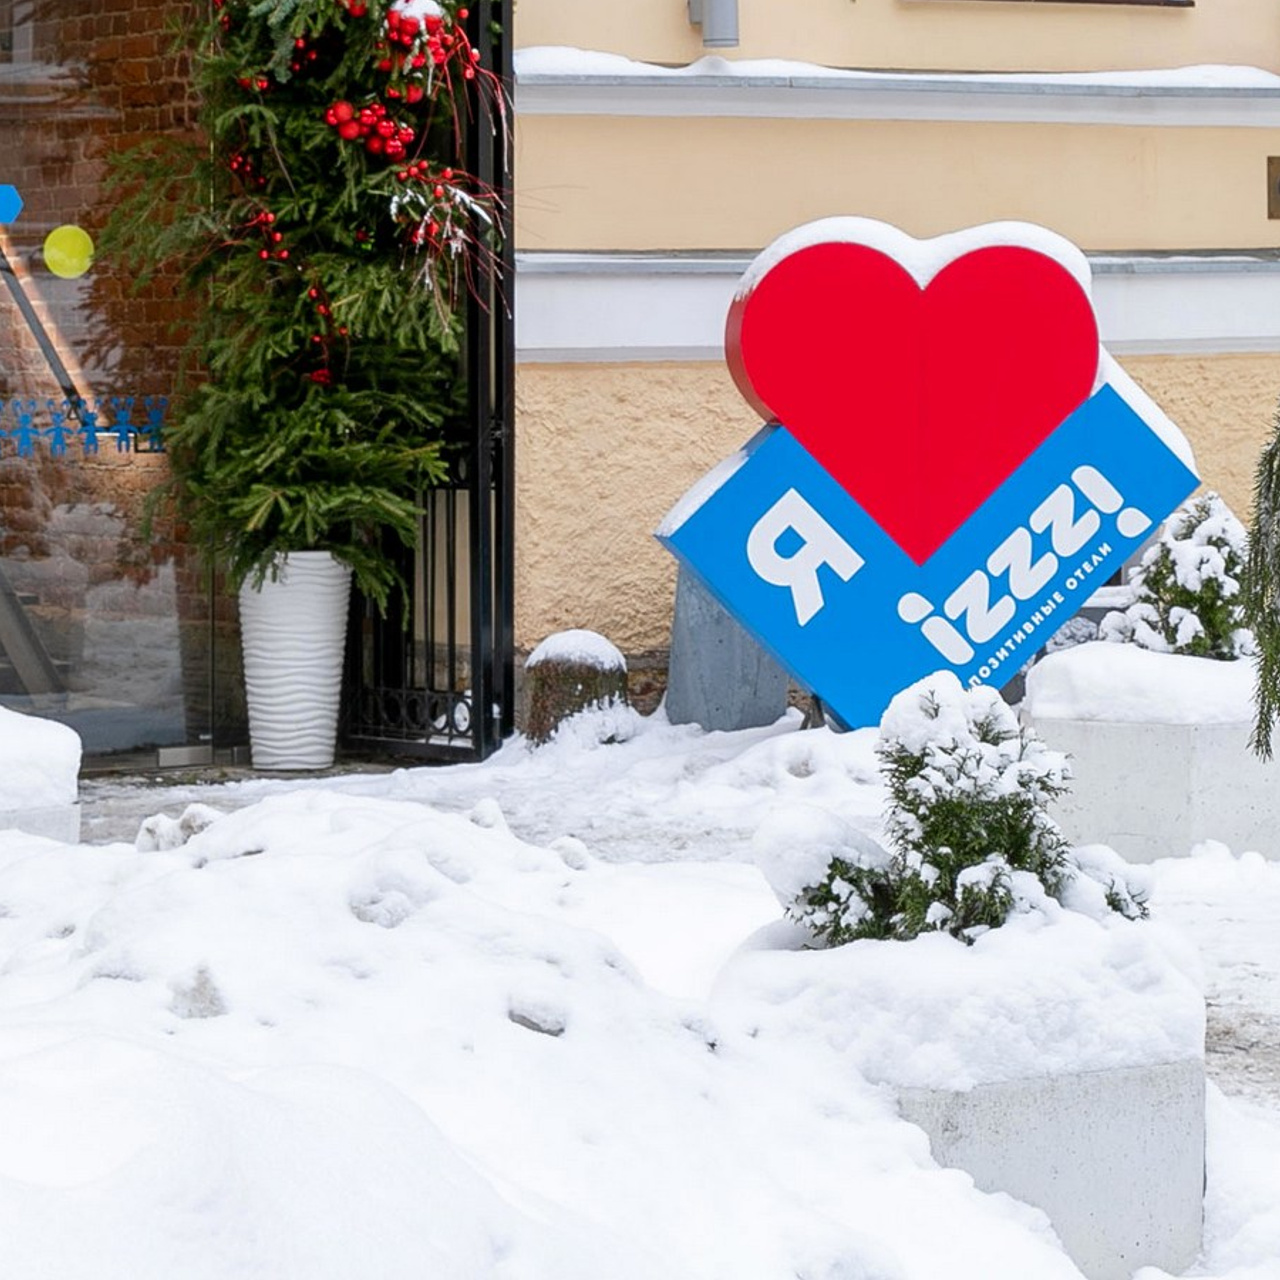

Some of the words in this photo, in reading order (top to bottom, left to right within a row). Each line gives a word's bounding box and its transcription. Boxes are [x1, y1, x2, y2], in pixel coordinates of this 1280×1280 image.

[747, 487, 865, 626] Я
[968, 591, 1065, 688] ПОЗИТИВНЫЕ
[1065, 542, 1112, 590] ОТЕЛИ
